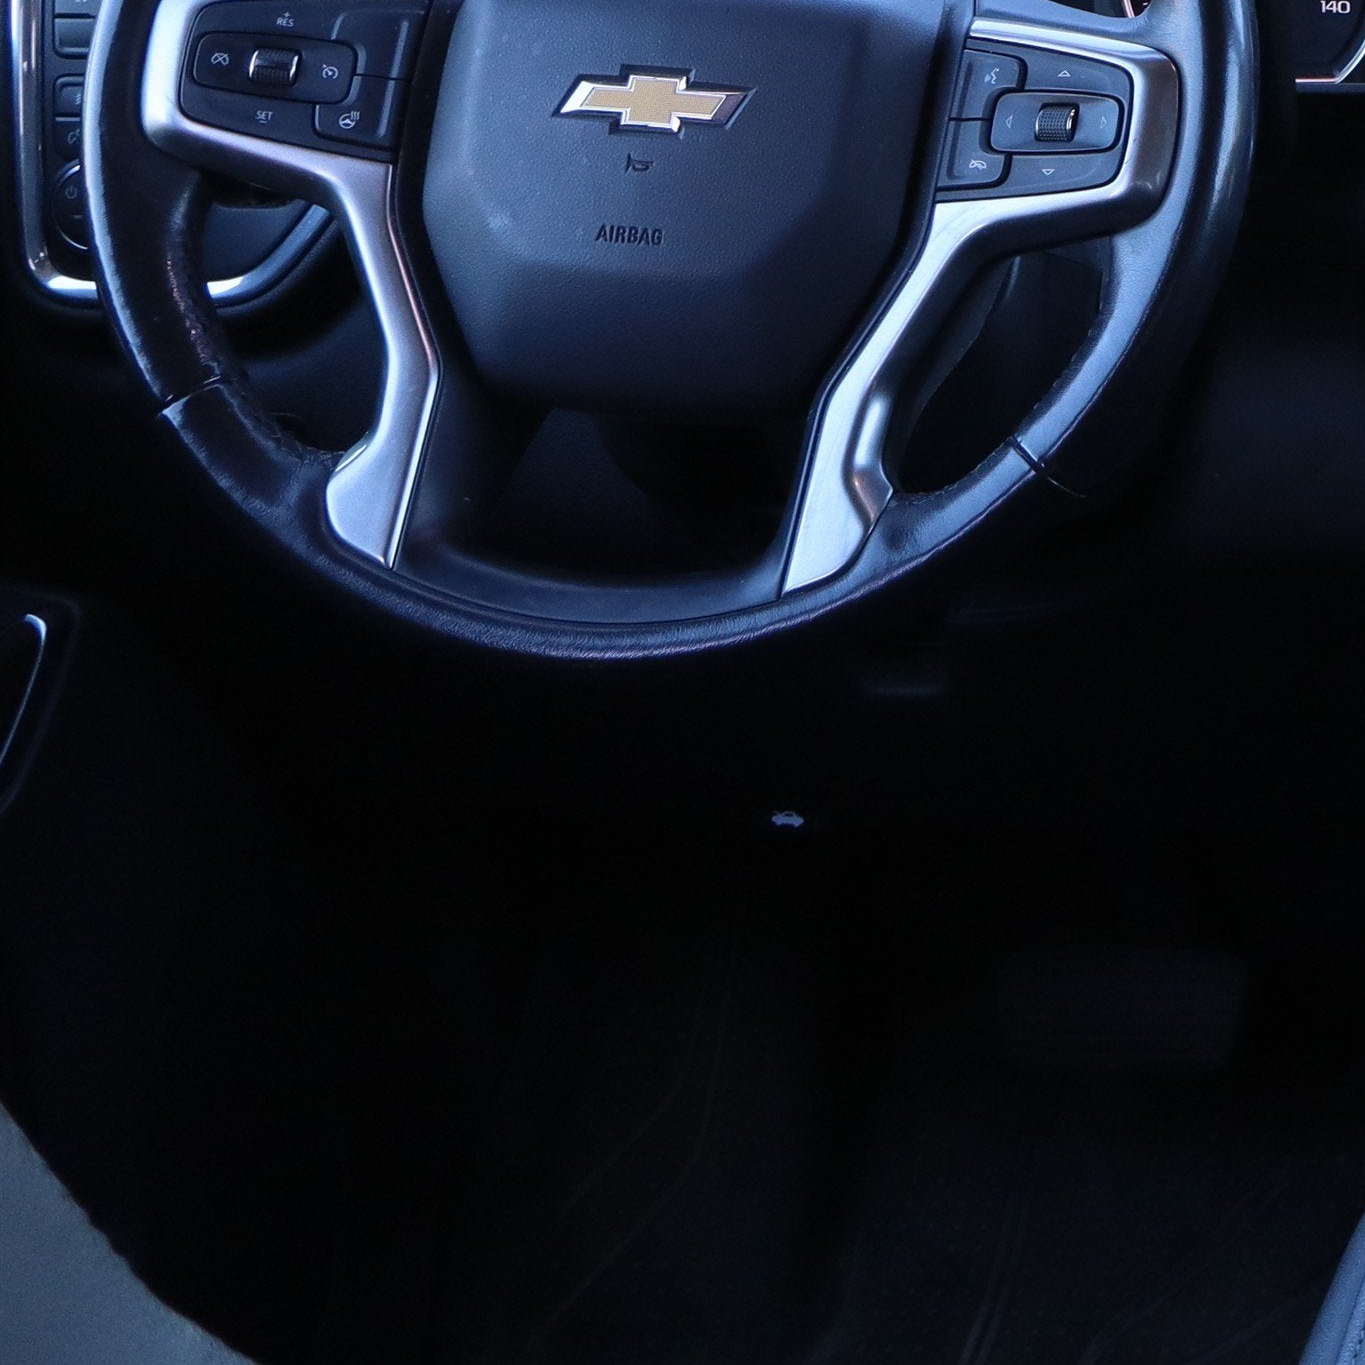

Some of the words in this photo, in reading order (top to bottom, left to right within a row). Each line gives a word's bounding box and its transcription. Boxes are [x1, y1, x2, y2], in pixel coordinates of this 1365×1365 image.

[1320, 0, 1351, 14] 140
[276, 17, 294, 27] RES
[256, 110, 273, 121] SET
[595, 223, 663, 246] AIRBAG
